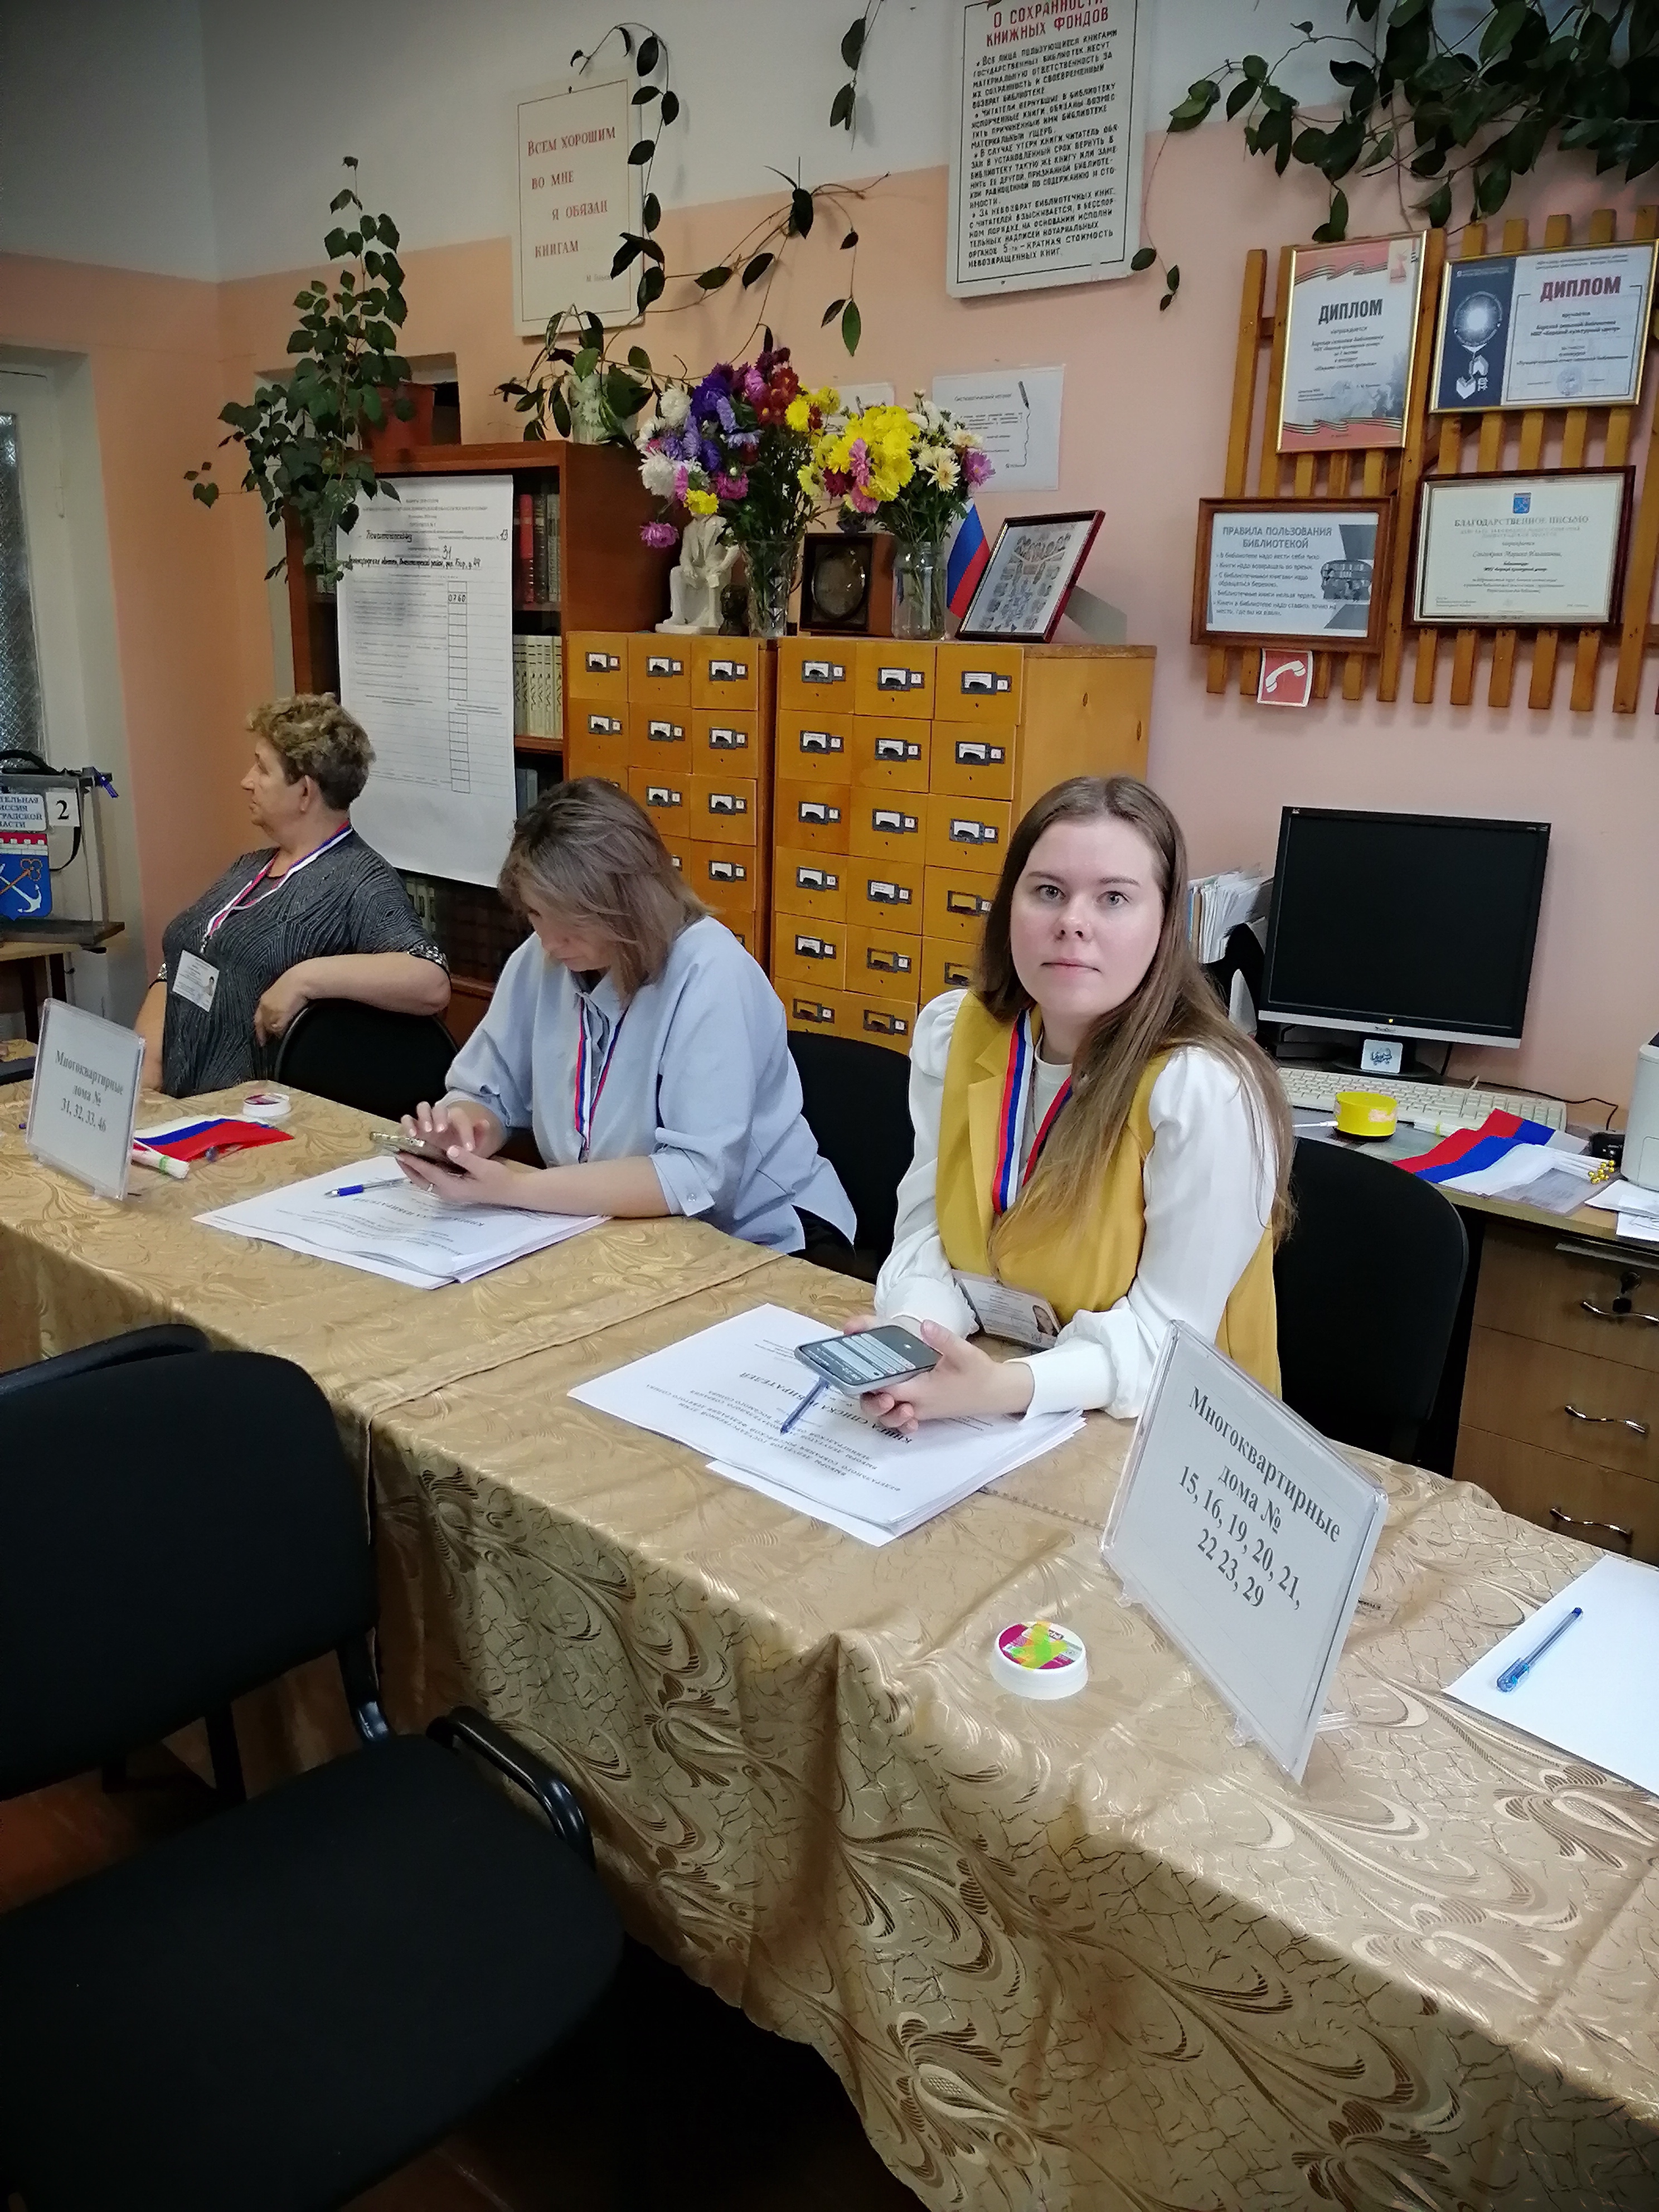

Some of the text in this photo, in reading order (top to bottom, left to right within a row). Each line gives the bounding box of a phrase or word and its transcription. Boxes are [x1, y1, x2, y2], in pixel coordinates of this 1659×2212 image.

[986, 7, 1109, 47] КНИЖНЫХ ФОНДОВ
[993, 0, 1103, 28] О СОХРАННОС
[1021, 37, 1079, 57] ПОЛЬЗУЮЩИЕСЯ
[1083, 29, 1117, 43] КНИГАМИ
[1086, 41, 1109, 52] НЕСУТ
[972, 62, 1104, 98] ИХ СОХРАННОСТЬ И СВОЕВРЕМЕННЫЙ
[973, 51, 1112, 88] МАТЕРИАЛЬНУЮ ОТВЕТСТВЕННОСТЬ ЗА
[972, 86, 1045, 109] ВОЗВРАТ БИБЛИОТЕКЕ
[1069, 83, 1115, 99] БИБЛИОТЕКУ
[1043, 114, 1058, 124] ИМИ
[1061, 104, 1107, 120] БИБЛИОТЕКЕ
[1050, 100, 1083, 113] ОБЯЗАНЫ
[980, 148, 984, 157] В
[987, 143, 1012, 155] СЛУЧАЕ
[1065, 127, 1099, 140] ЧИТАТЕЛЬ
[1054, 143, 1071, 153] СРОК
[1075, 137, 1104, 149] ВЕРНУТЬ
[970, 149, 1094, 180] БИБЛИОТЕКУ ТАКУЮ ЖЕ КНИГУ ИЛИ
[985, 182, 1028, 196] РАВНОЦЕННОЙ
[1032, 180, 1040, 188] ПО
[1043, 171, 1089, 186] СОДЕРЖАНИЮ
[552, 200, 608, 220] Я ОБЯЗАН
[979, 208, 988, 217] ЗА
[1035, 191, 1092, 207] БИБЛИОТЕЧНЫХ
[969, 229, 983, 238] НОМ
[1022, 221, 1030, 230] НА
[1034, 215, 1074, 227] ОСНОВАНИИ
[969, 221, 1099, 248] ТЕЛЬНЫХ НАДПИСЕЙ НОТАРИАЛЬНЫХ
[1065, 229, 1113, 244] СТОИМОСТЬ
[536, 240, 578, 258] КНИГАМ
[968, 251, 1036, 268] НЕВОЗВРАЩЕННЫХ
[1540, 276, 1621, 303] ДИПЛОМ
[1318, 298, 1383, 325] ДИПЛОМ
[1223, 526, 1332, 536] ПРАВИЛА ПОЛЬЗОВАНИЯ
[1454, 516, 1589, 527] БЛАГОДАРСТВЕННОЕ ПИСЬМО
[1243, 537, 1308, 548] БИБЛИОТЕКОЙ
[56, 800, 69, 820] 2
[56, 1050, 123, 1095] Многоквартирные
[73, 1084, 101, 1107] дома №
[61, 1098, 72, 1116] 31,
[73, 1104, 84, 1122] 32,
[98, 1118, 106, 1132] 46
[739, 1372, 913, 1444] КНИГА СПИСКА ИБИРАТЕЛЕЙ
[1189, 1386, 1341, 1542] Многоквартирные
[1218, 1465, 1282, 1534] дома №
[1178, 1466, 1301, 1610] 15, 16, 19, 20, 21,
[1197, 1527, 1265, 1608] 22 23, 29
